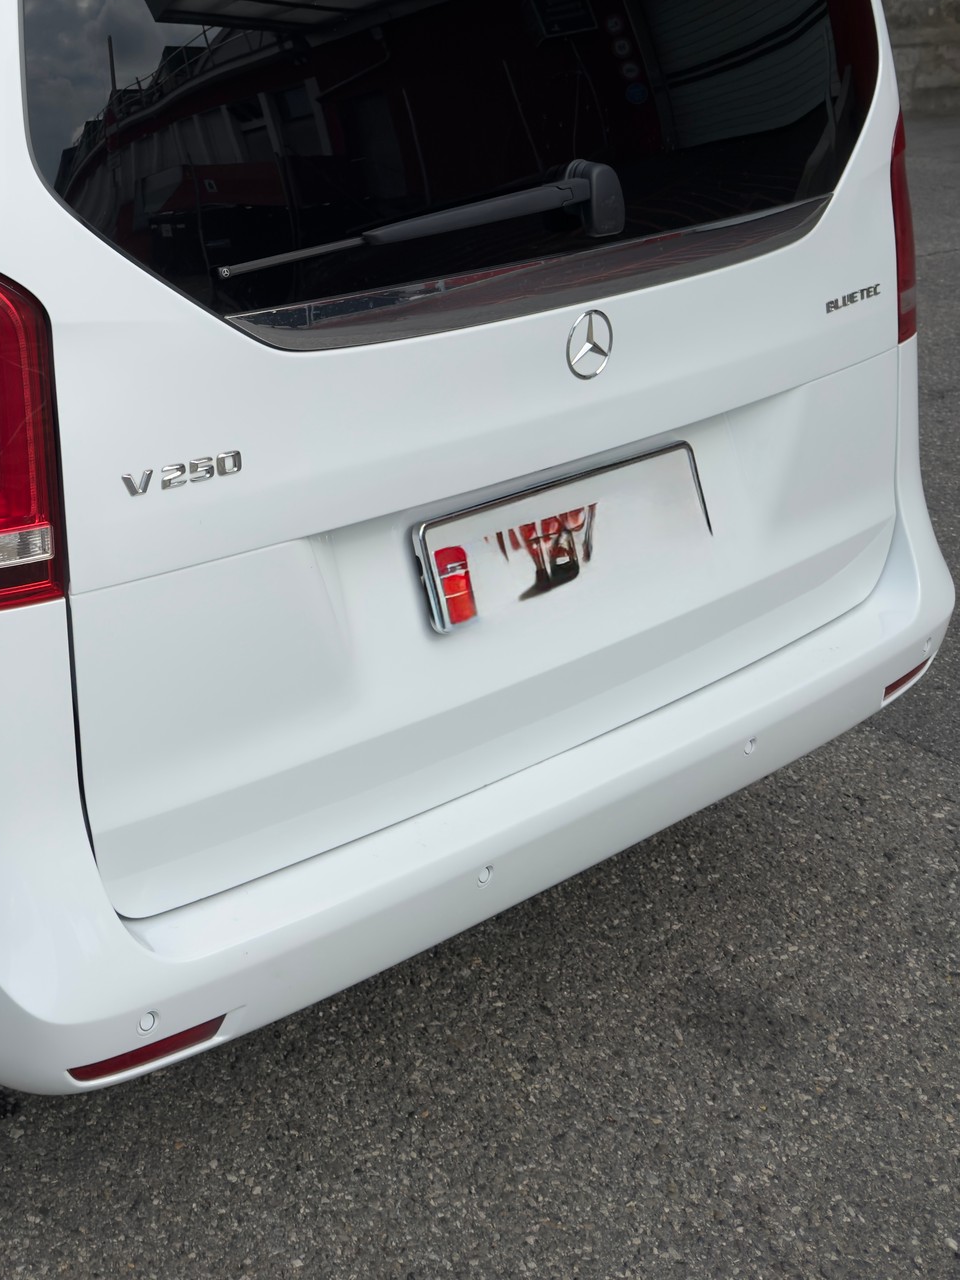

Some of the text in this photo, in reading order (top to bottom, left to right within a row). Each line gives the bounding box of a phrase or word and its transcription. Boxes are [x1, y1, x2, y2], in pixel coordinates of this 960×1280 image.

[825, 283, 881, 314] BLUETEC
[121, 450, 242, 496] V 250
